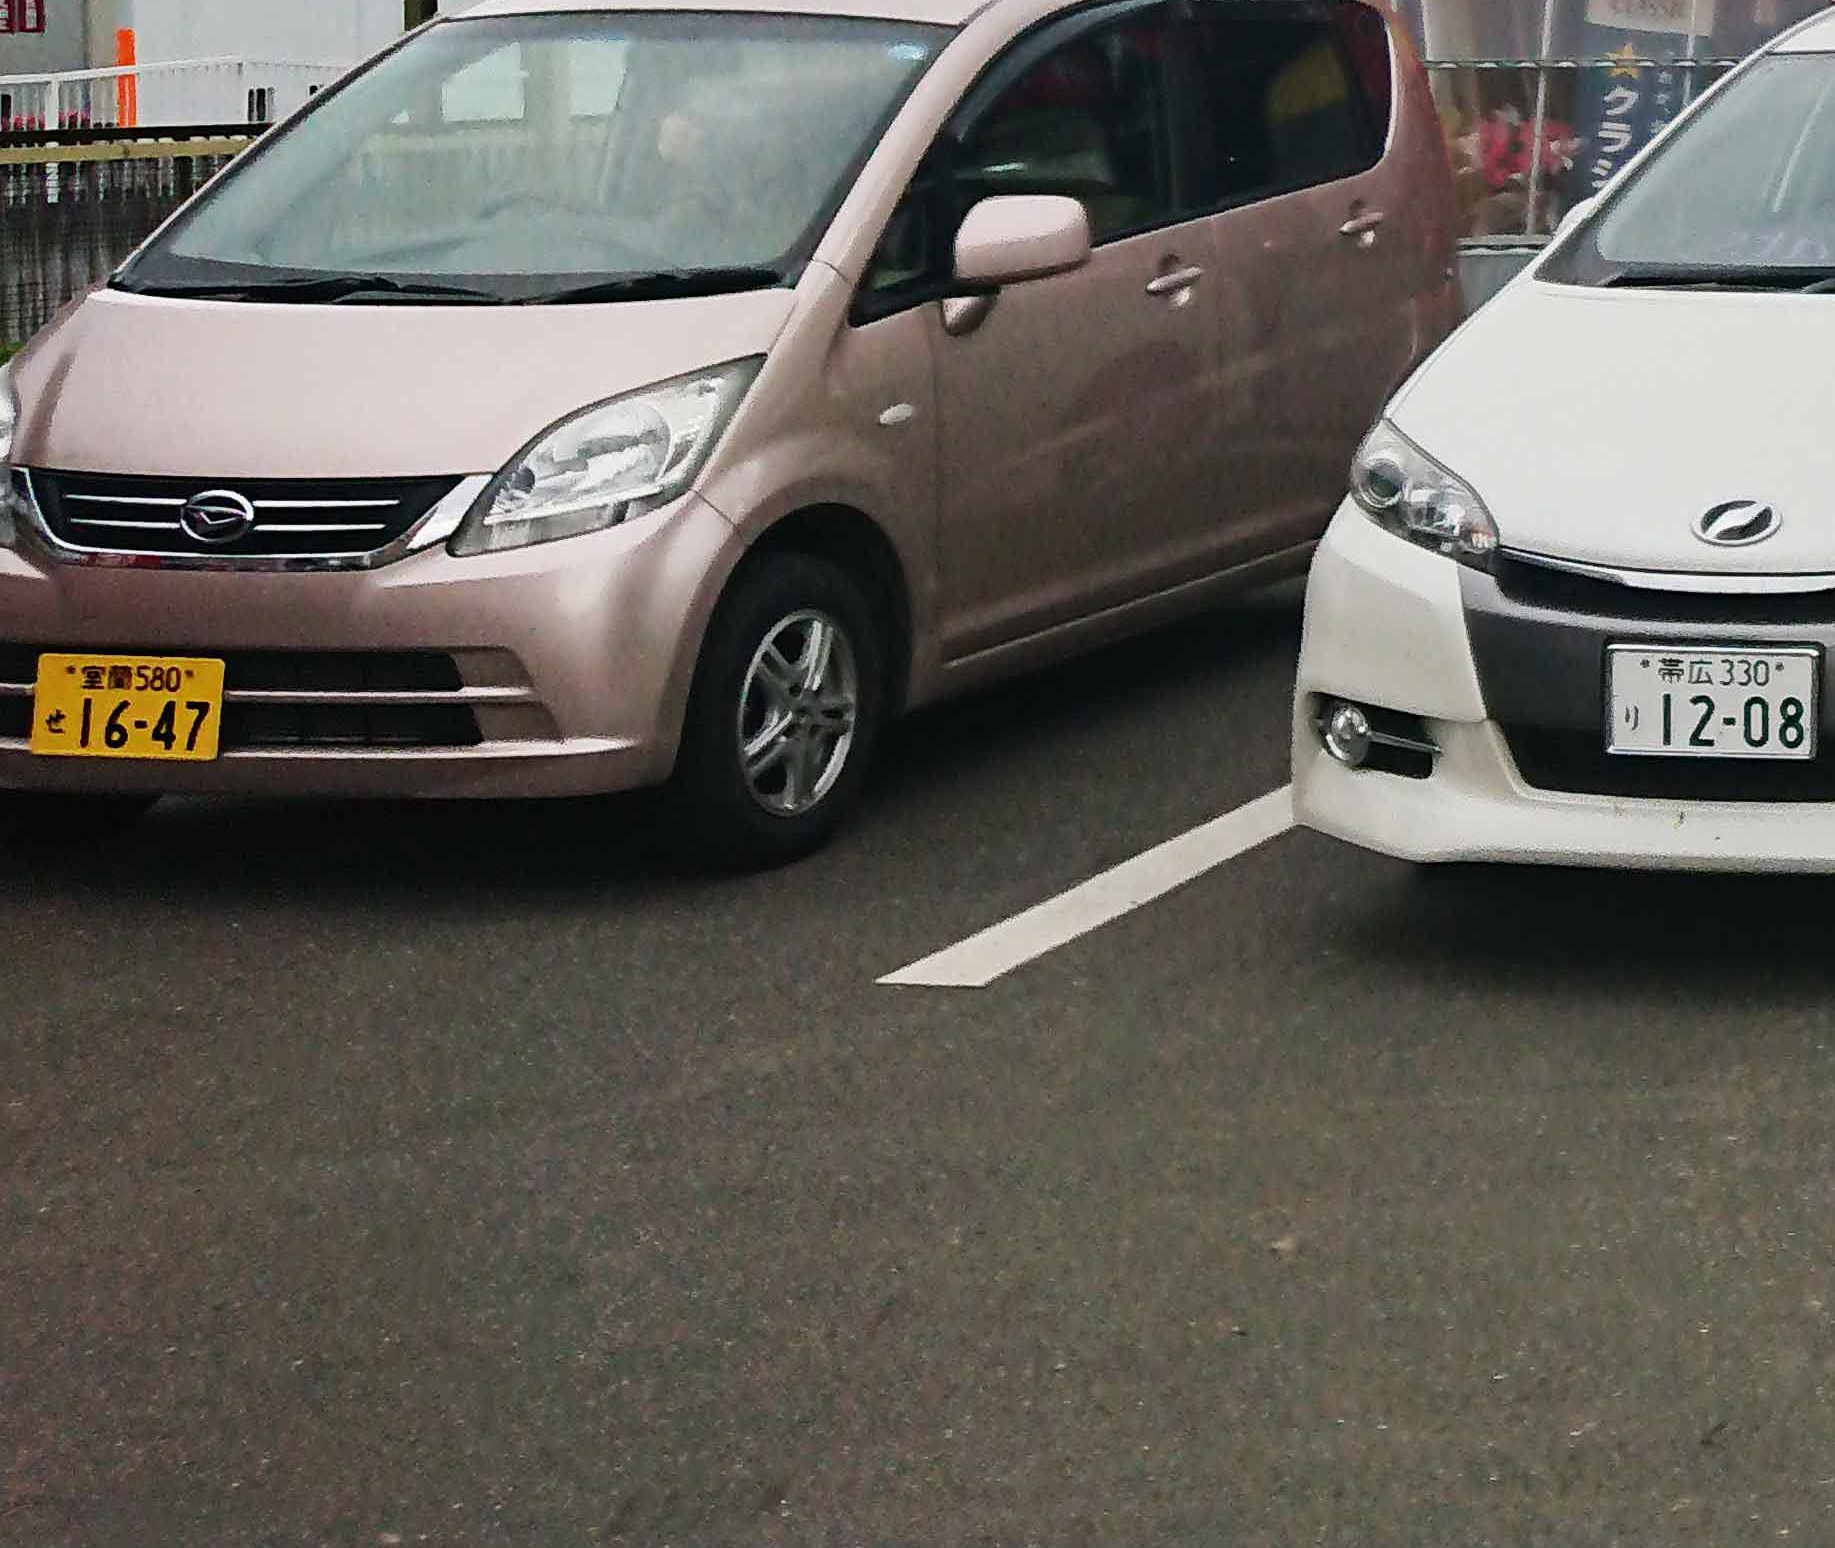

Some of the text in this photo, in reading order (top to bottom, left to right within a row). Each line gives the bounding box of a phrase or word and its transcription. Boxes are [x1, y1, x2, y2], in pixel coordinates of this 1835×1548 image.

[45, 697, 210, 751] せ 16-47
[1624, 693, 1805, 749] り 12-08
